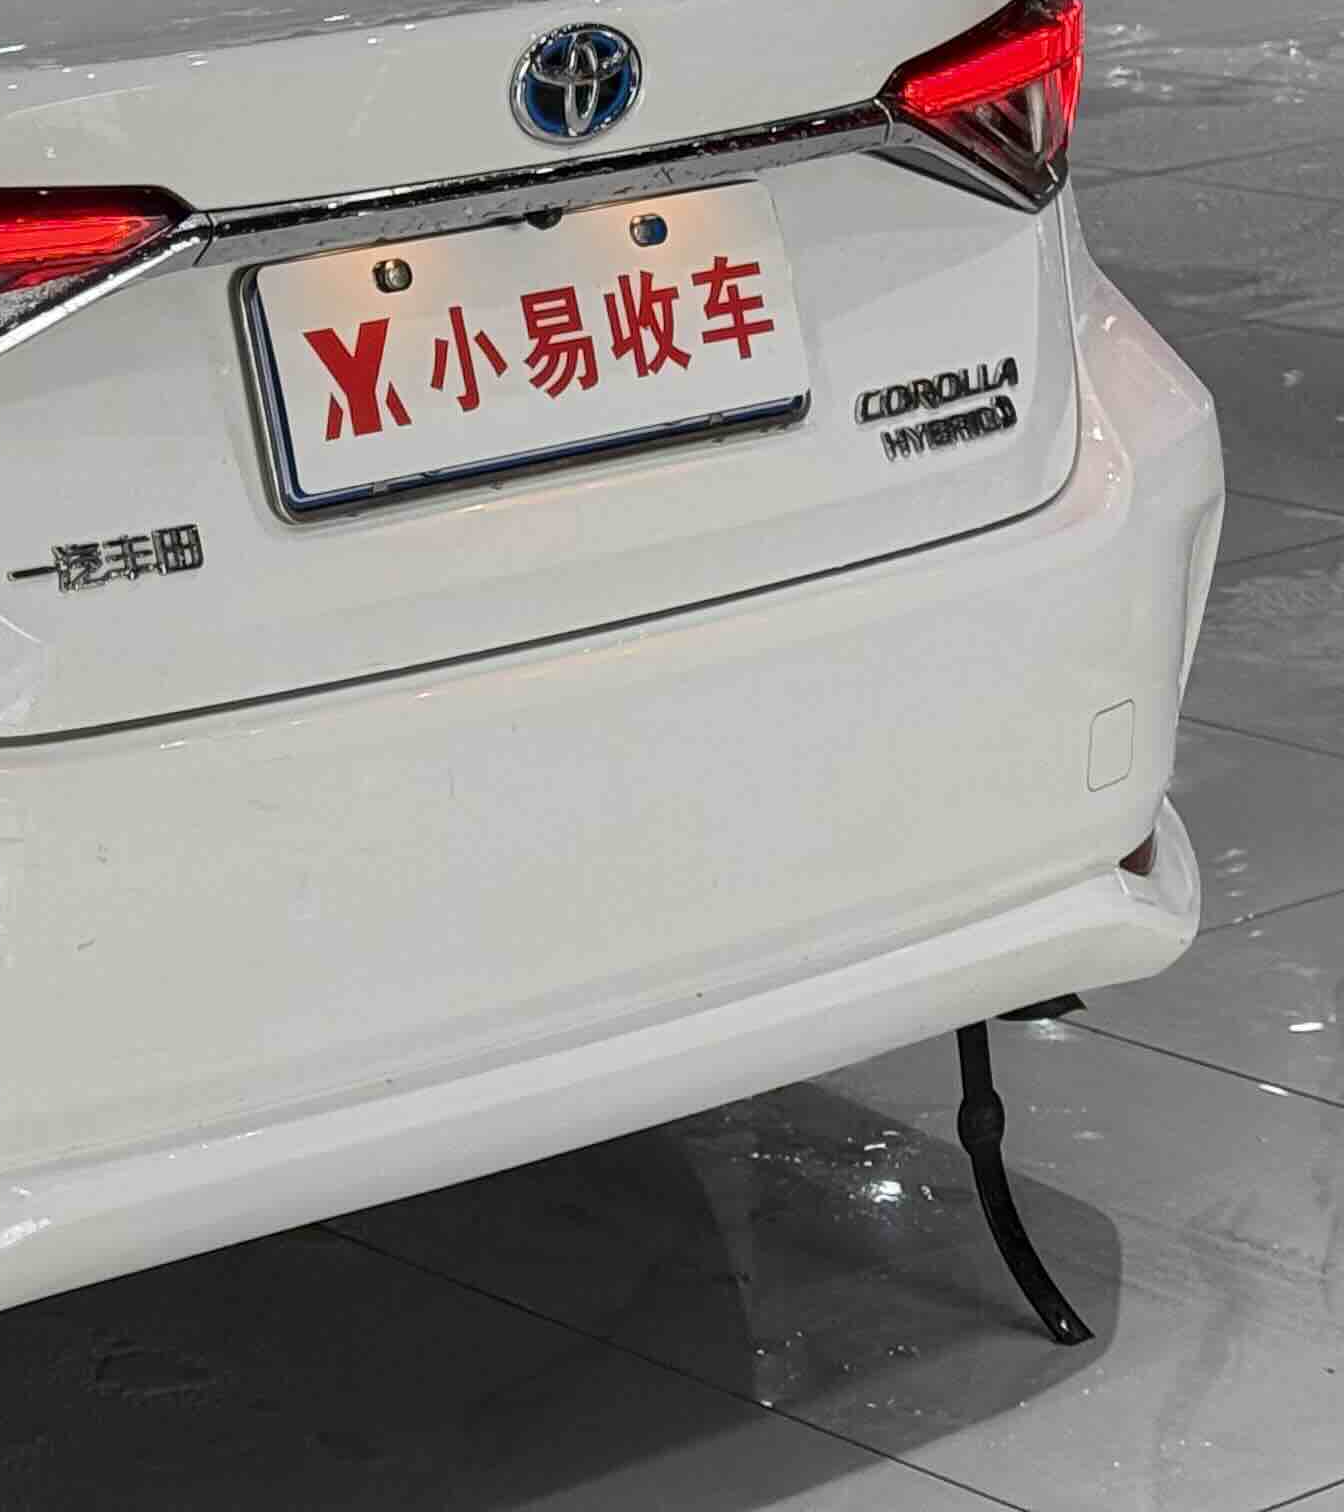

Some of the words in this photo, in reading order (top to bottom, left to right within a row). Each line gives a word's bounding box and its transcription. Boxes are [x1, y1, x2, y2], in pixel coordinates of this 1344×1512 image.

[429, 255, 775, 412] 小易收车
[854, 356, 1019, 425] COROLLA
[880, 398, 1012, 462] HYBRID
[7, 523, 205, 592] 一汽丰田
